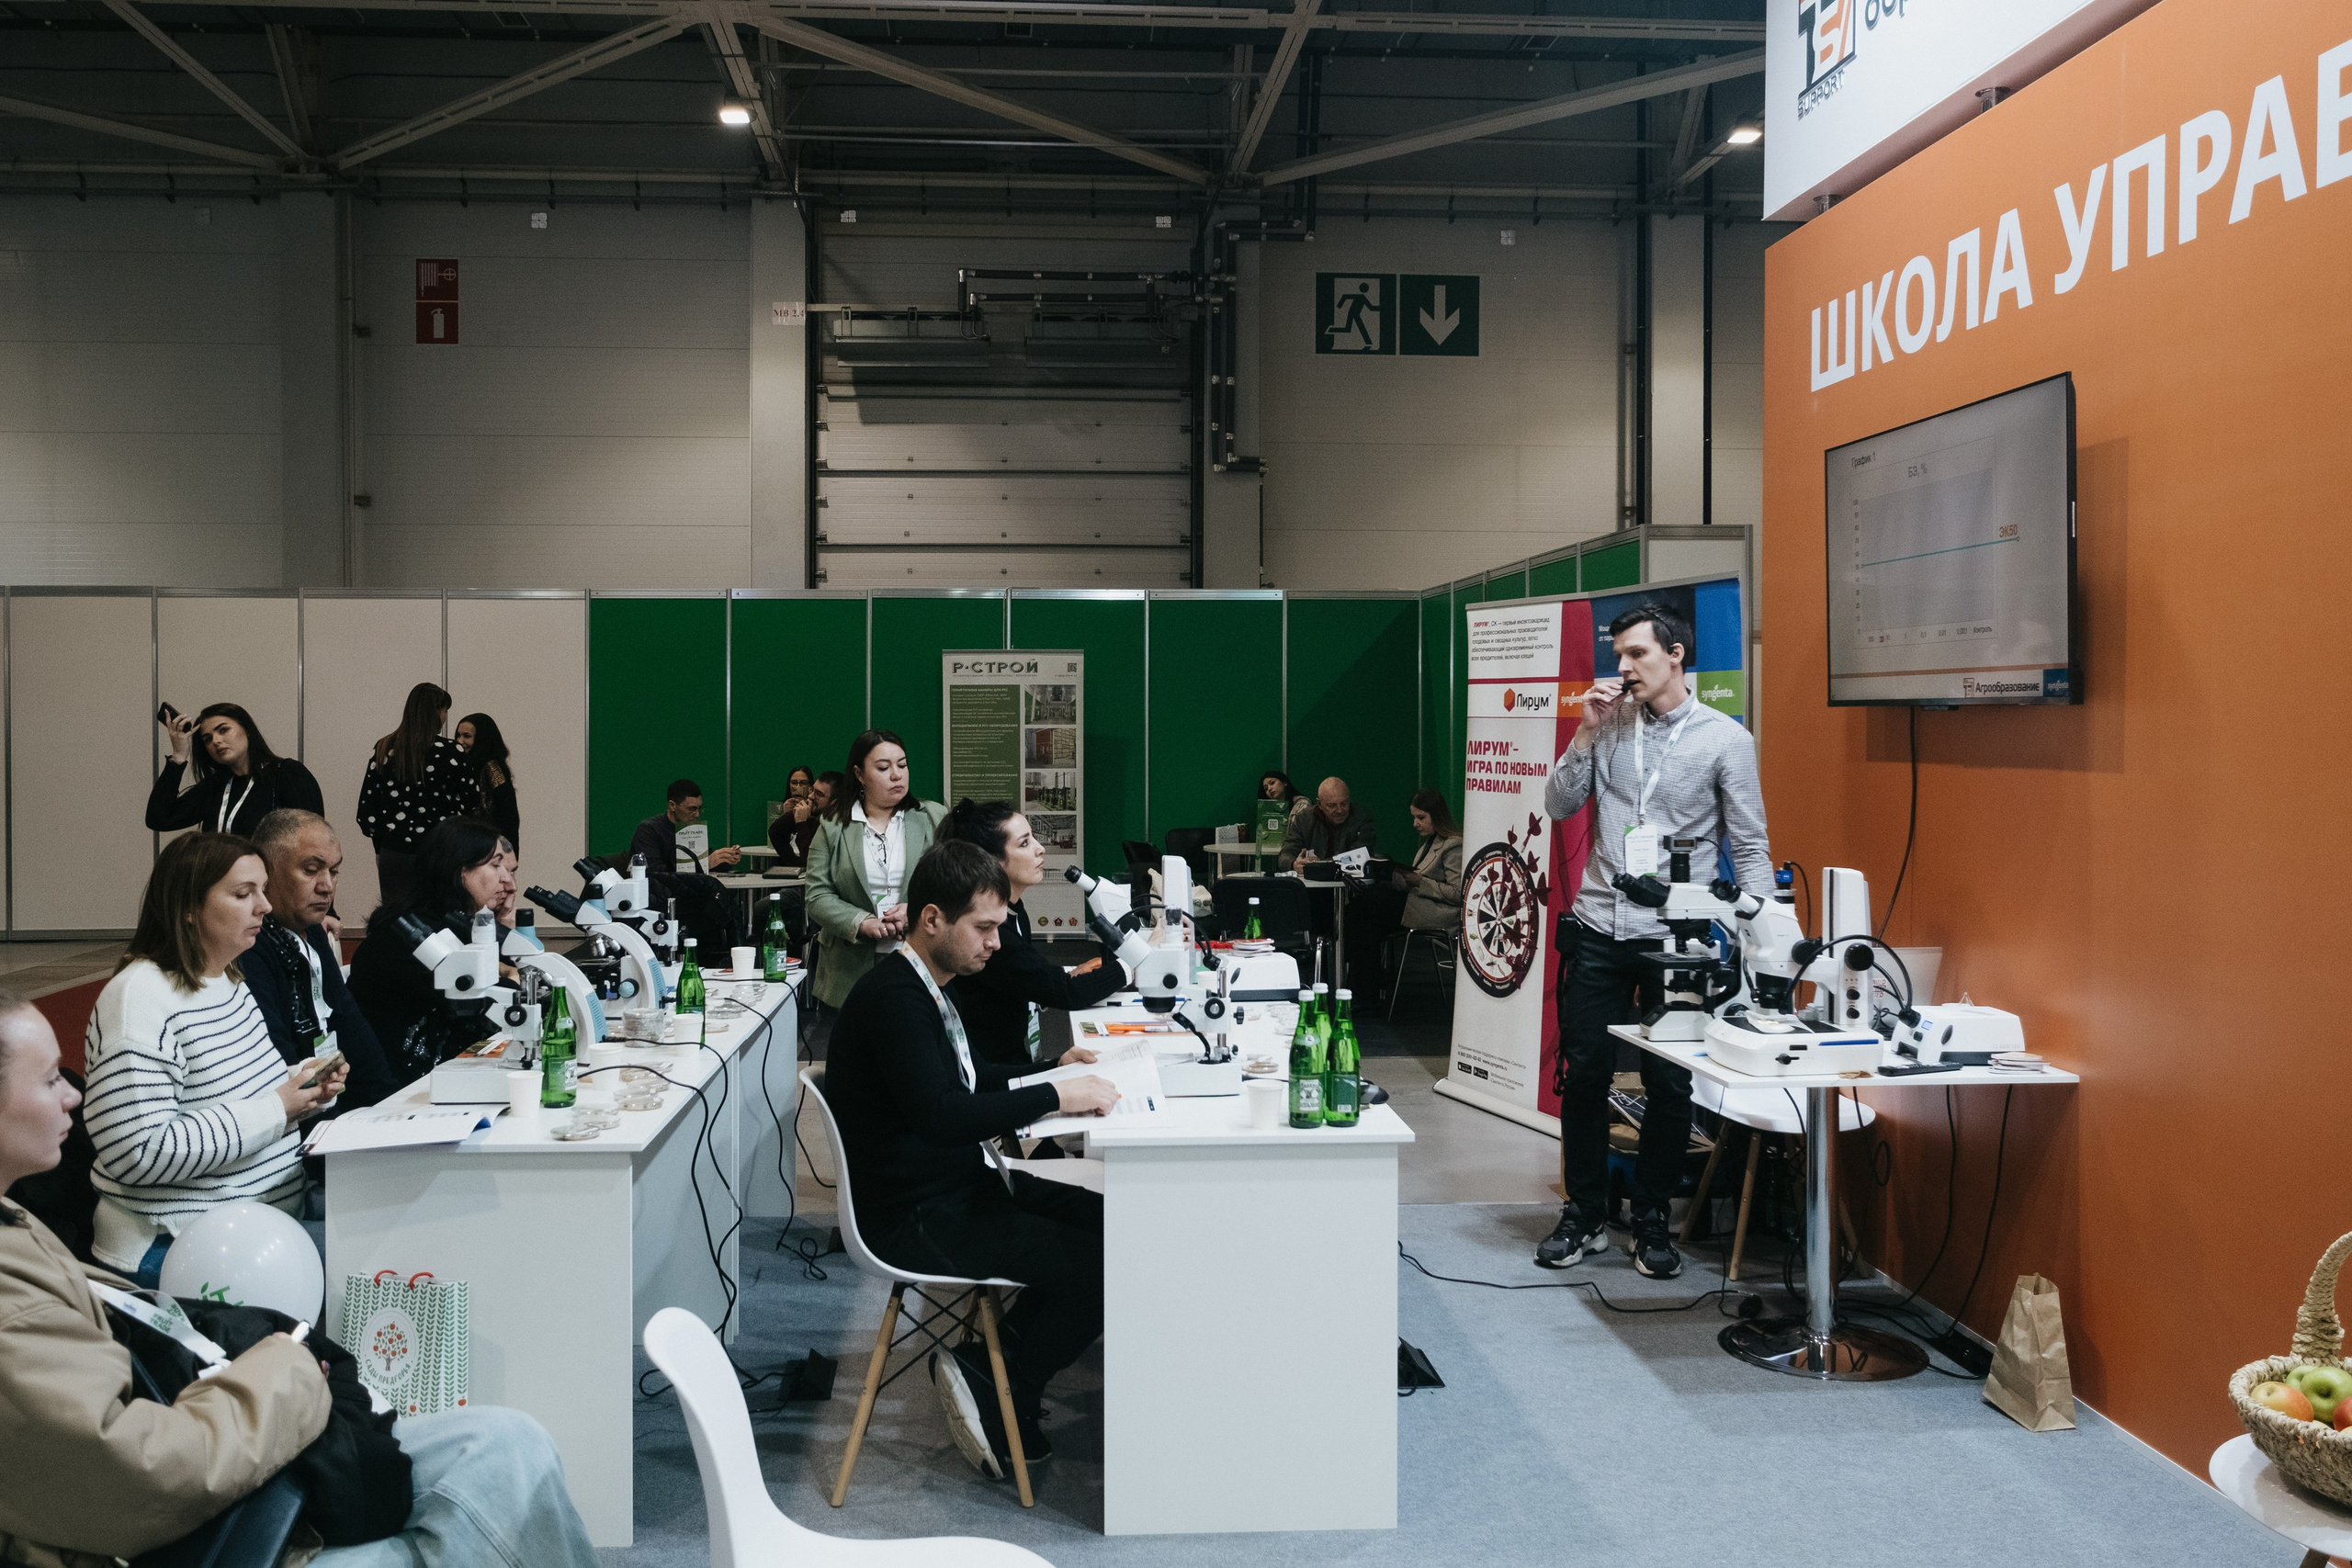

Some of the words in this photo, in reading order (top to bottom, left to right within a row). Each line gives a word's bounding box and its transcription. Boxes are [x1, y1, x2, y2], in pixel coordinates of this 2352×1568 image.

[1798, 69, 1845, 120] SUPPORT
[1811, 208, 2033, 392] ШКОЛА
[1975, 682, 2040, 695] Агрообразование
[1561, 692, 1583, 706] syngent
[1466, 760, 1492, 774] ИГРА
[1495, 761, 1508, 774] ПО
[1510, 761, 1547, 776] НОВЫМ
[1466, 778, 1521, 794] ПРАВИЛАМ
[365, 1359, 379, 1378] САДЫ
[379, 1363, 411, 1385] ПРЕДГОРЬЯ
